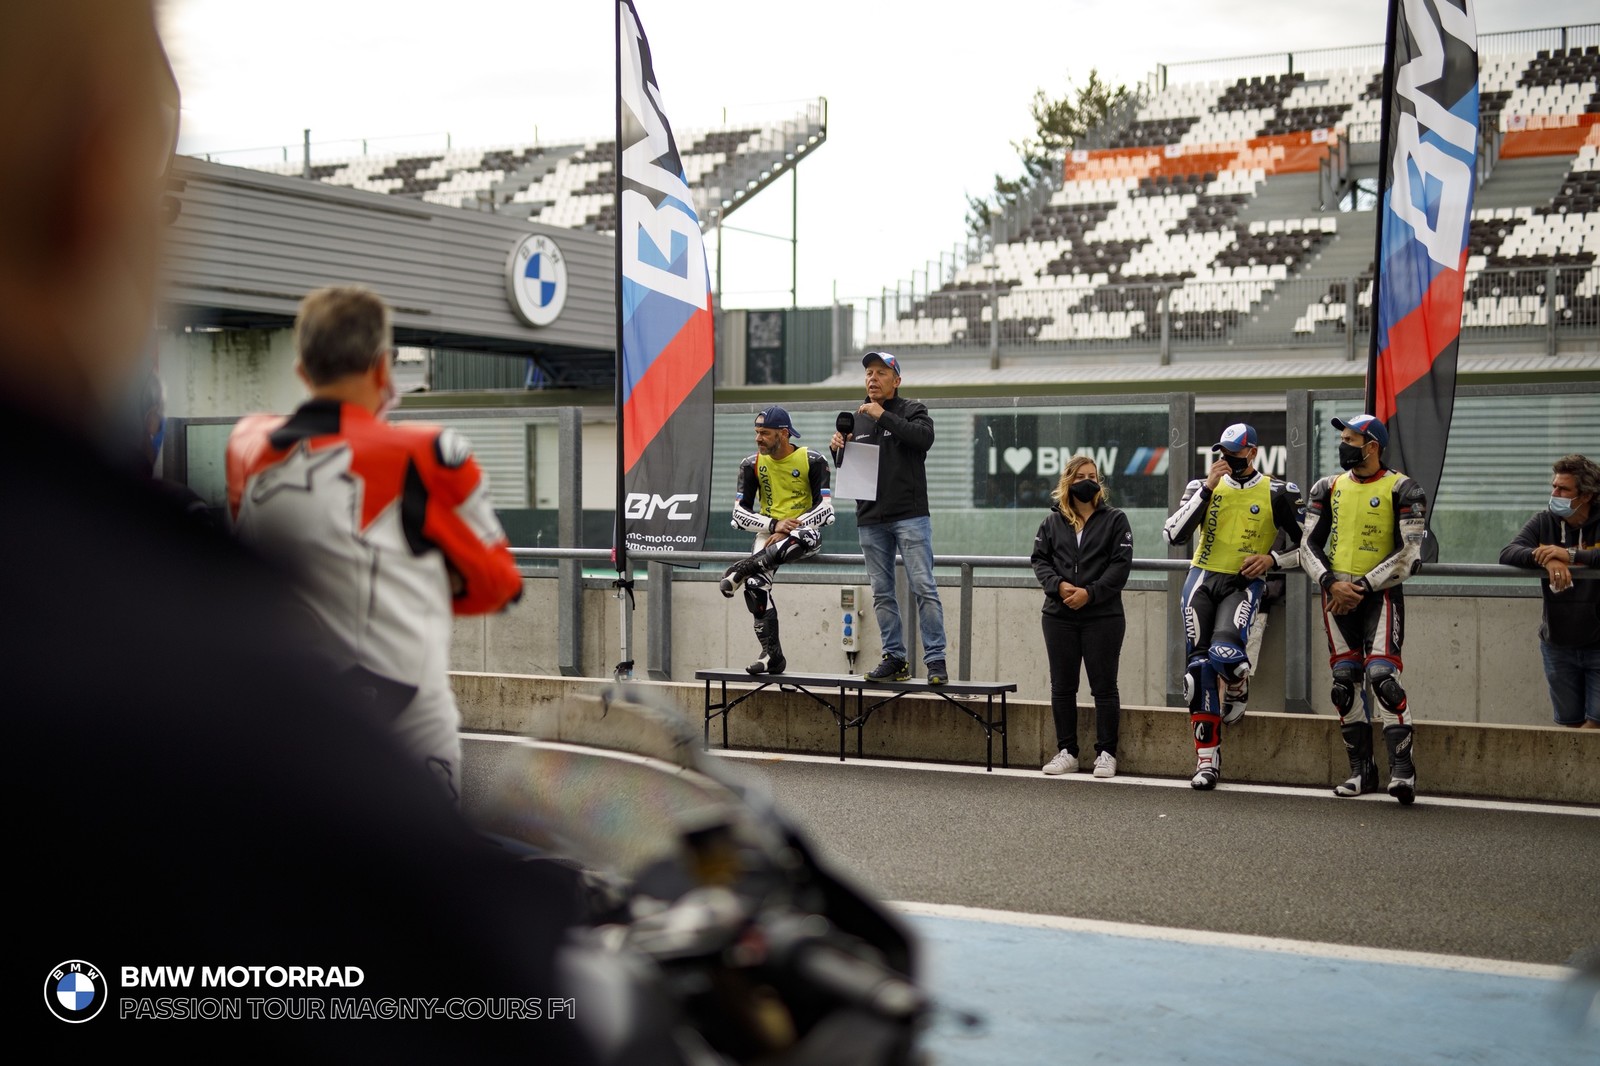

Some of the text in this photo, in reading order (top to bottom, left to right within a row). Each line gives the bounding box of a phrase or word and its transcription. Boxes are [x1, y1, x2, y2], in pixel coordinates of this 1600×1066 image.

[1038, 446, 1119, 475] BMW
[1197, 446, 1287, 476] TWN
[625, 493, 698, 520] BMC
[1198, 494, 1223, 566] TRACKDAYS
[1185, 606, 1196, 638] BMW
[1237, 600, 1251, 628] BMW
